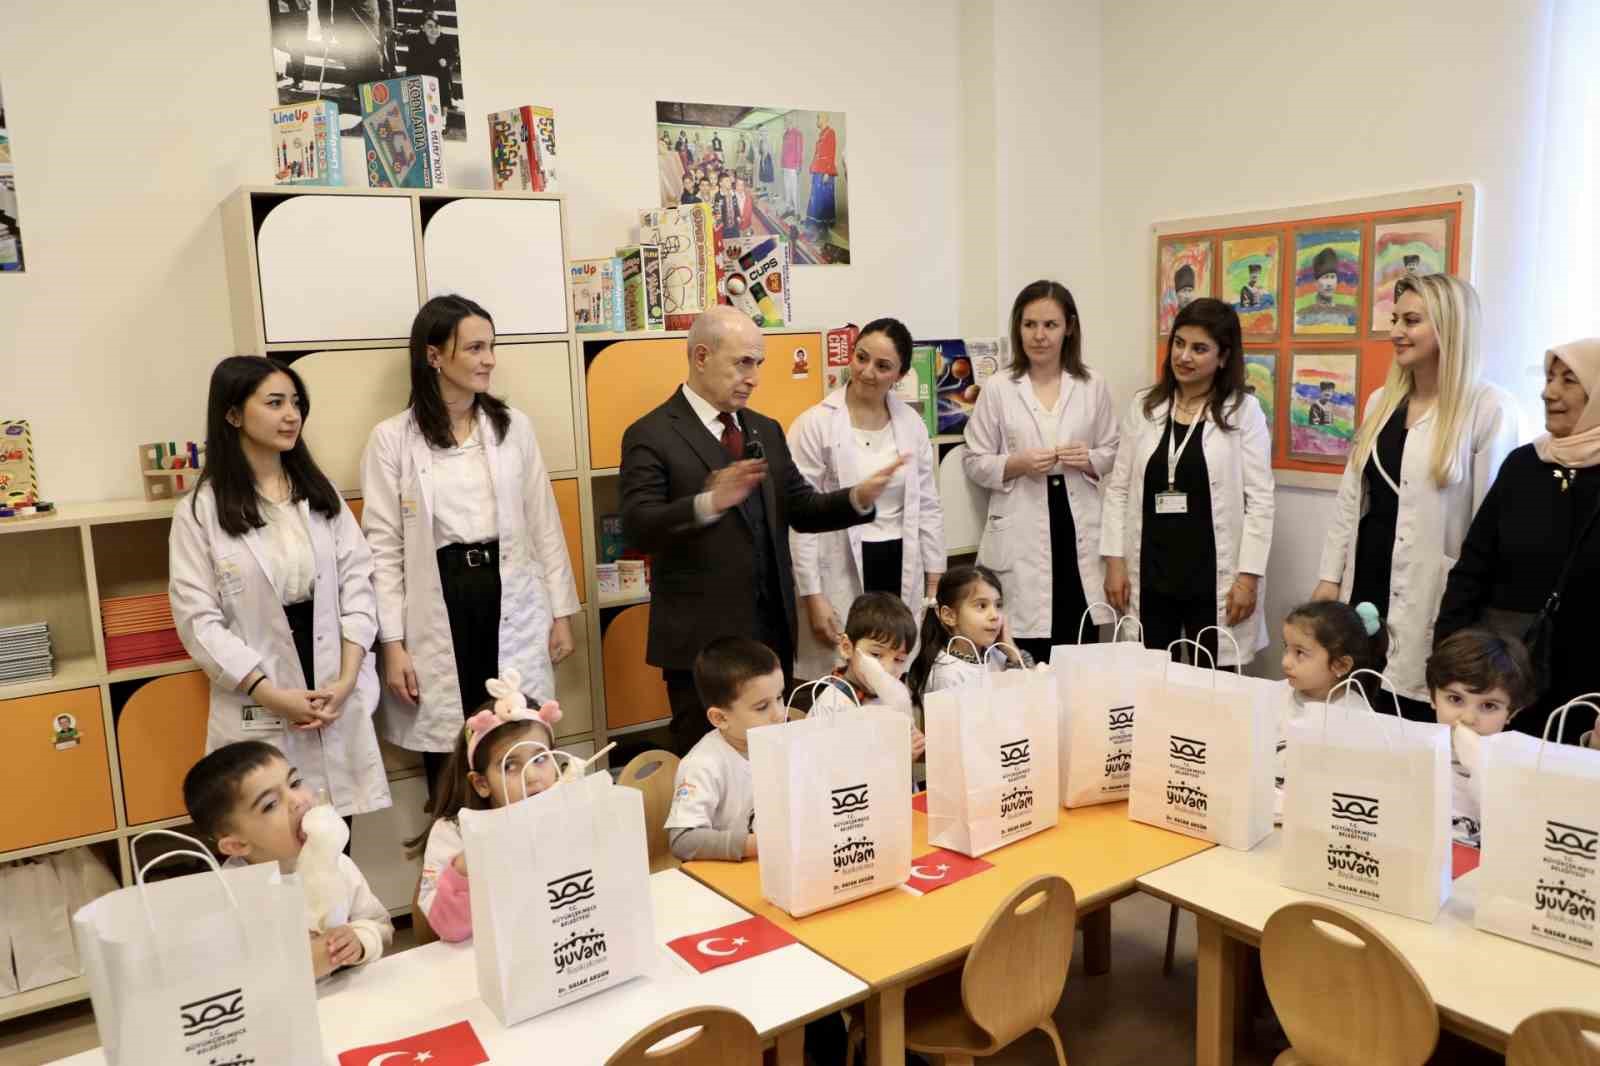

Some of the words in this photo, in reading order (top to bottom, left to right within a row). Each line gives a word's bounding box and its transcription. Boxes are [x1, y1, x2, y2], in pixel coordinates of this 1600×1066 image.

[273, 109, 310, 125] LineUp
[407, 80, 425, 152] KODLAMA
[570, 264, 597, 276] neUp
[749, 257, 778, 281] CUPS
[829, 334, 841, 363] CITY
[1105, 760, 1130, 777] yuva
[1000, 796, 1032, 818] yuvam
[1166, 790, 1207, 811] yuvam
[833, 848, 874, 872] yuvam
[1328, 855, 1379, 878] yuvam
[1535, 892, 1595, 921] yuvam
[554, 940, 607, 974] yuvam
